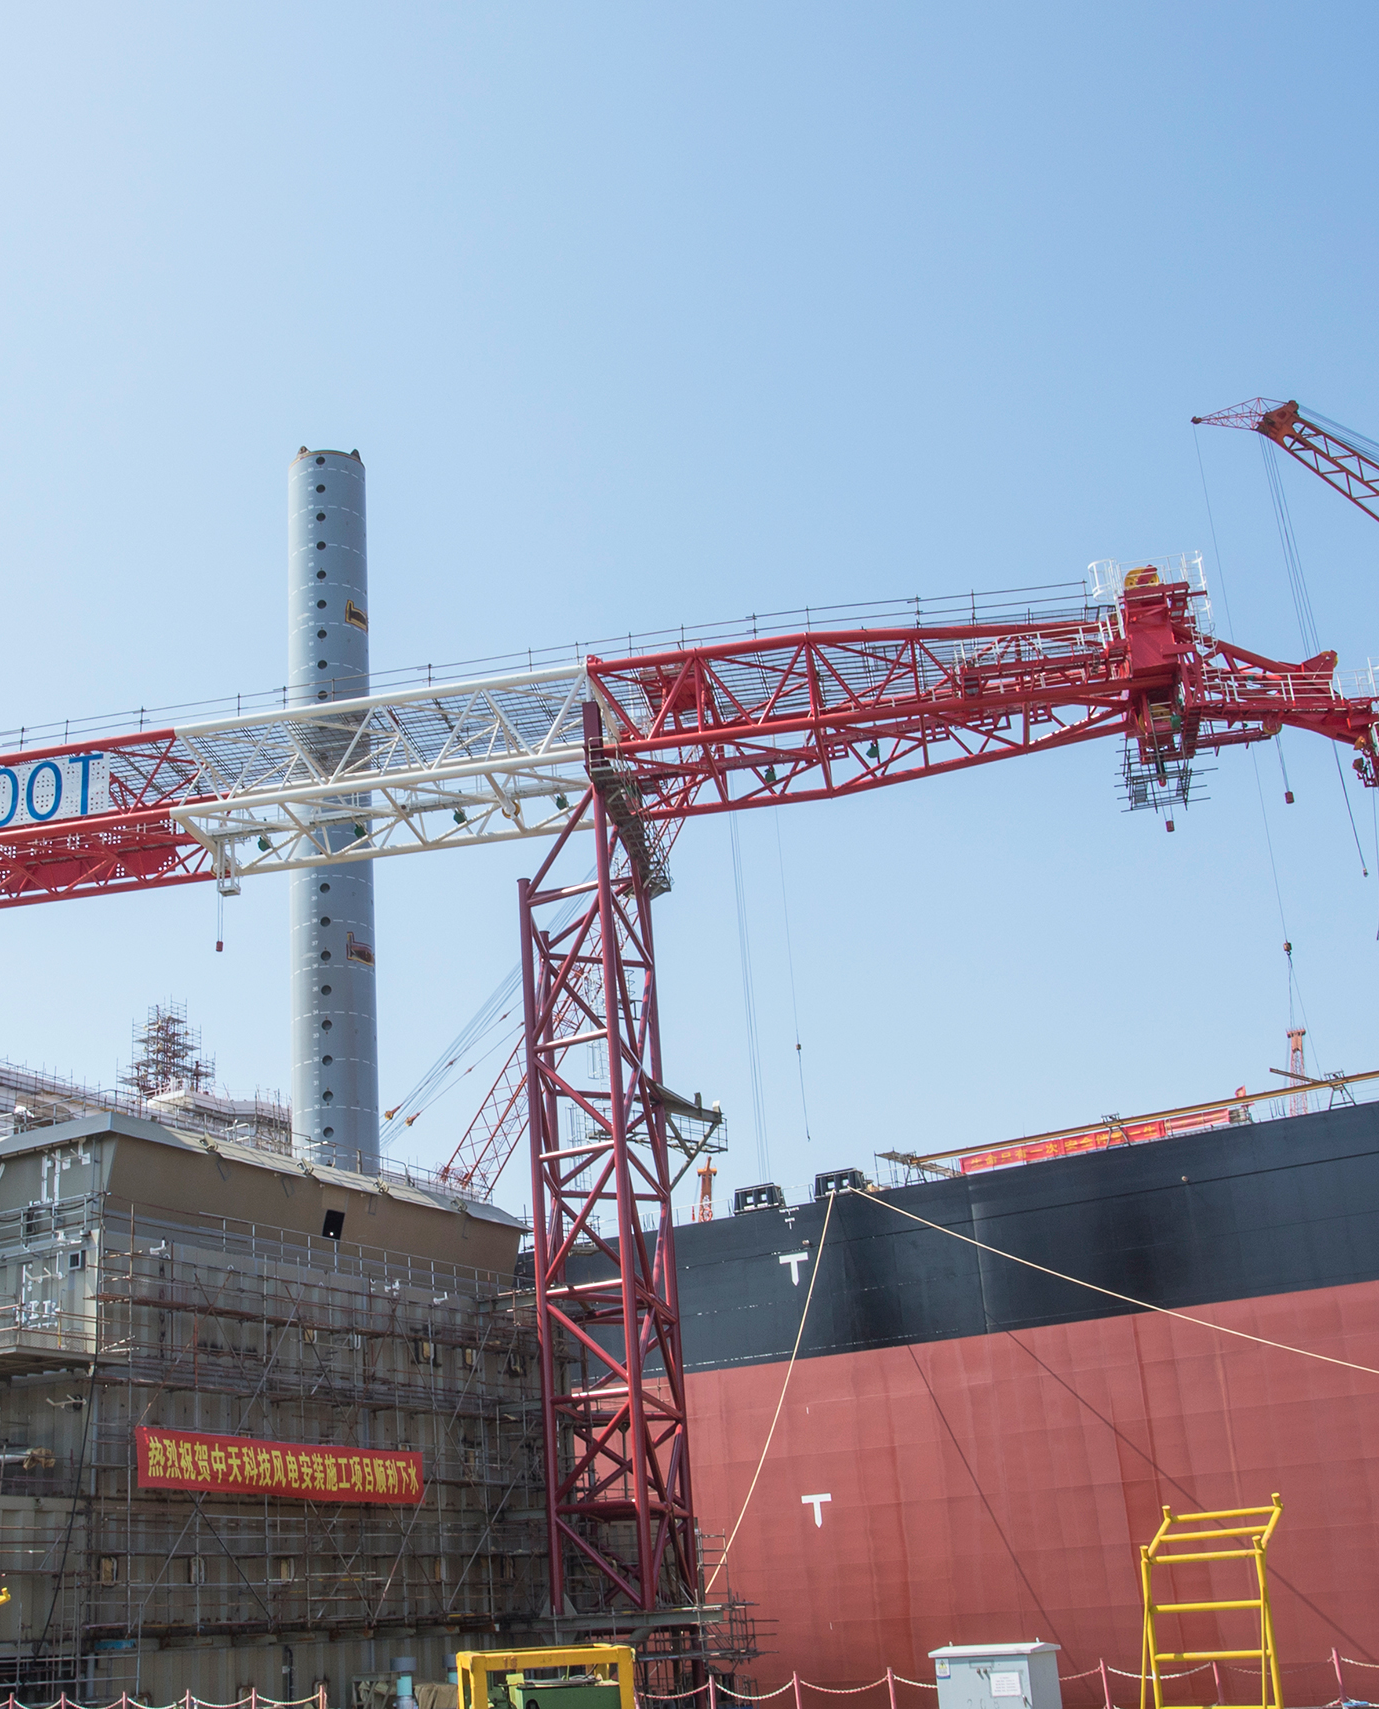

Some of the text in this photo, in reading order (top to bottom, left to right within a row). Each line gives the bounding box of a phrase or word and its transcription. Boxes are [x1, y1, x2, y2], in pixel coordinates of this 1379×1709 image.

[148, 1436, 419, 1495] 热烈祝贺中天科技风电安装施工项目顺利下水
